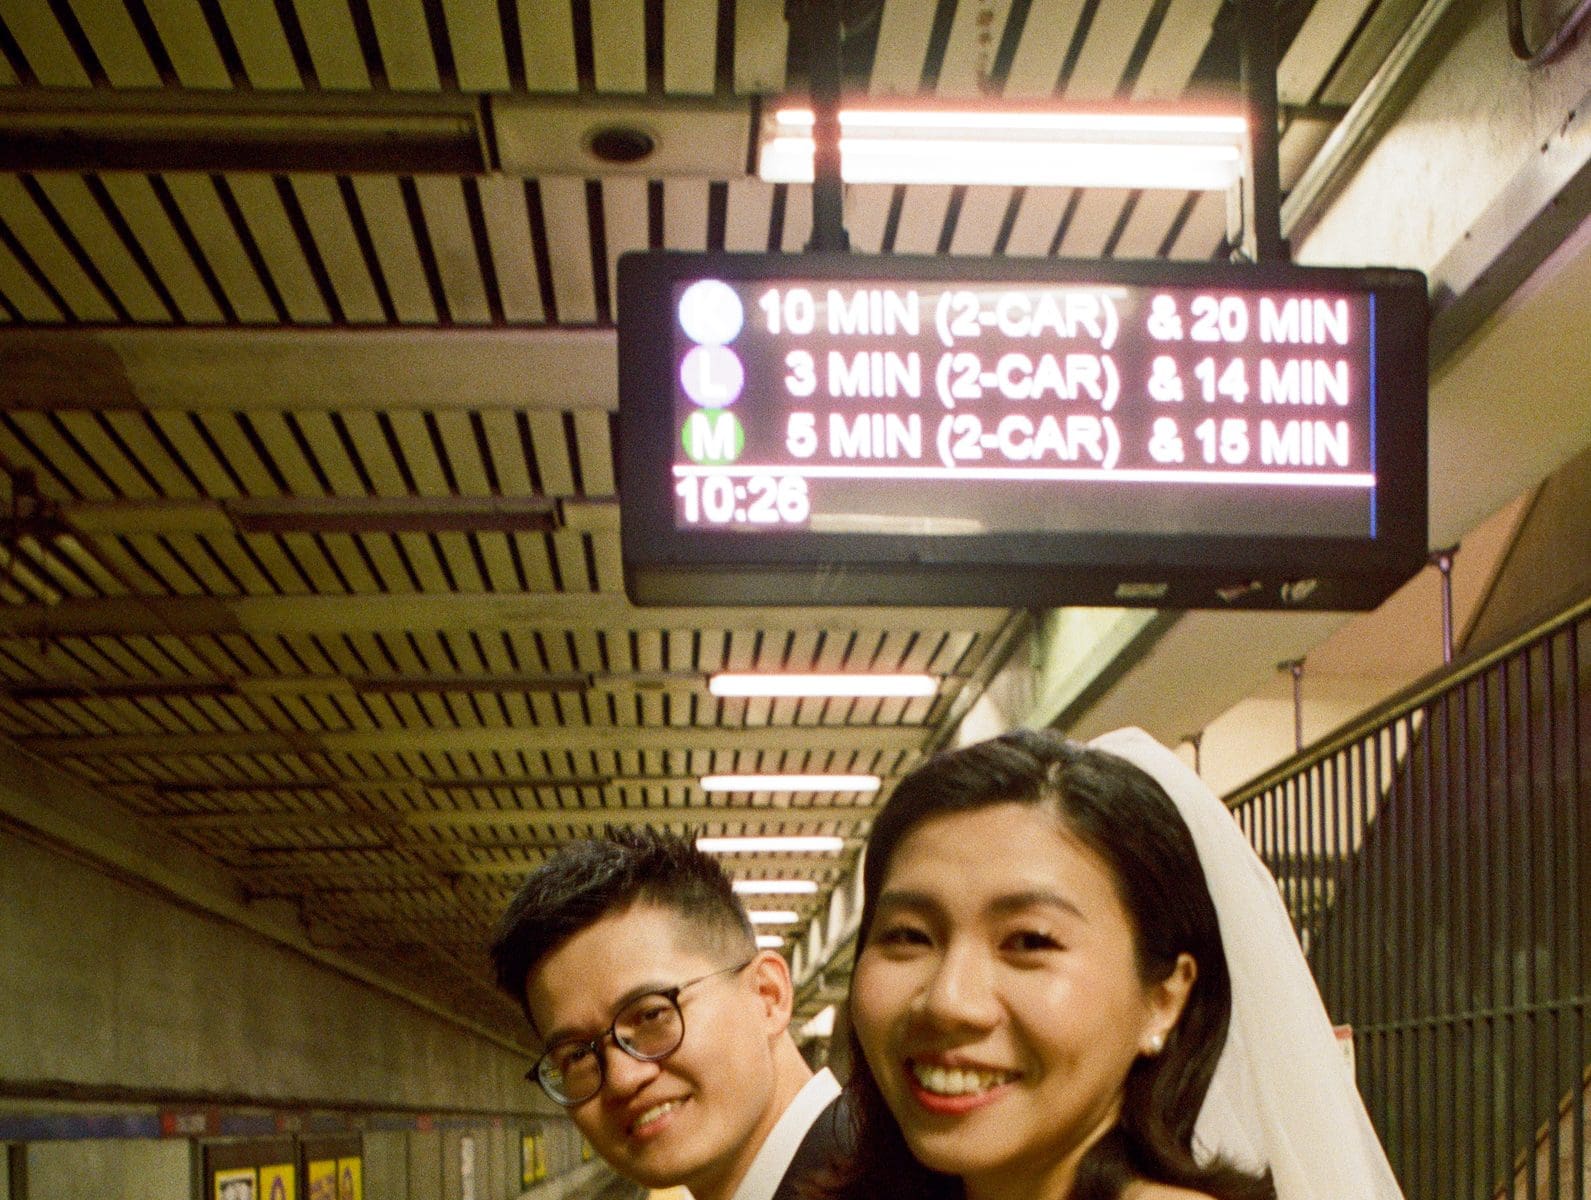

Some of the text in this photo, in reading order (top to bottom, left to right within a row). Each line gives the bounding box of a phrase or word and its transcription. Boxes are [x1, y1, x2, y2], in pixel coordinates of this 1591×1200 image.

[759, 288, 816, 335] 10
[826, 288, 920, 336] MIN
[935, 290, 1120, 350] (2-CAR)
[1147, 294, 1184, 340] &
[1190, 295, 1249, 342] 20
[1259, 297, 1349, 345] MIN
[699, 350, 1349, 411] L 3 MIN (2-CAR) & 14 MIN
[691, 411, 1349, 469] M 5 MIN (2-CAR) & 15 MIN
[675, 476, 810, 523] 10:26
